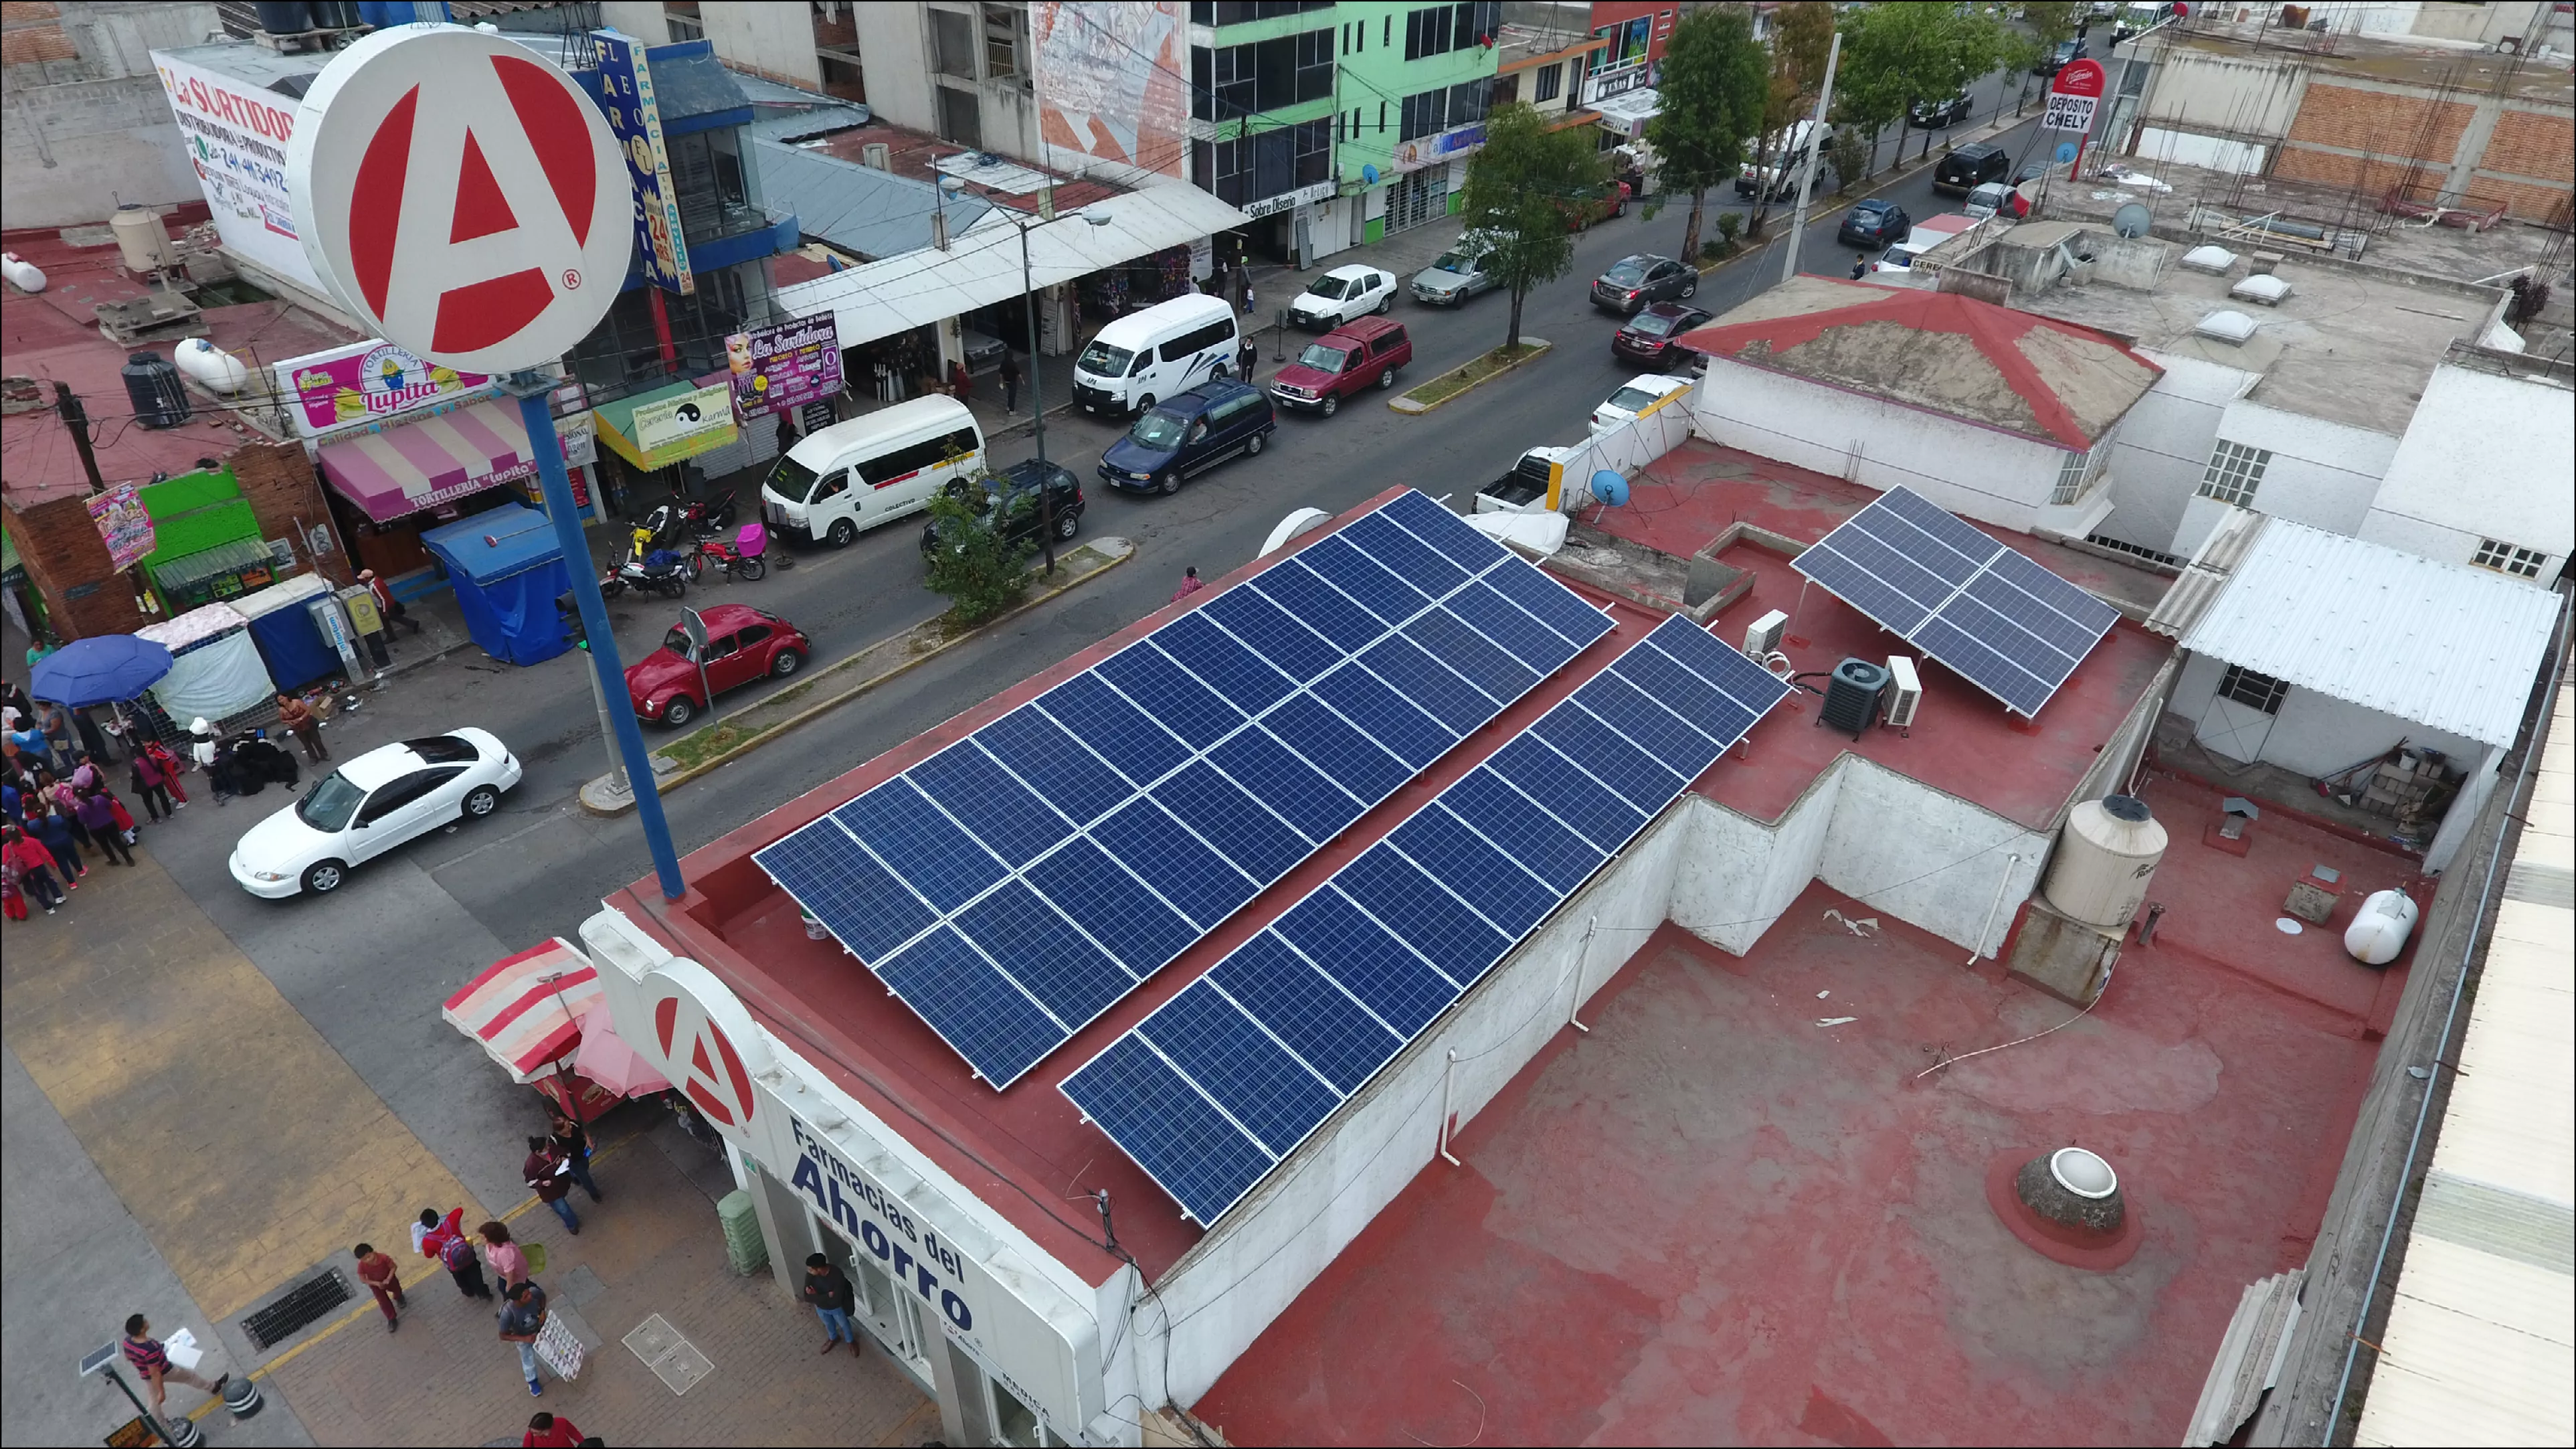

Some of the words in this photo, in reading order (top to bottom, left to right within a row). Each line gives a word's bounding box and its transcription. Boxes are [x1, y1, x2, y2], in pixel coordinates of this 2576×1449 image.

[169, 68, 193, 107] La
[634, 45, 668, 171] FARMACIA
[2046, 112, 2089, 129] CHELY
[2049, 96, 2094, 114] DEPOSITO
[1250, 202, 1271, 218] Sobre
[1272, 194, 1296, 213] Diseño
[650, 214, 668, 244] 24
[668, 207, 686, 268] SERVICIO
[680, 271, 692, 283] 24
[753, 339, 773, 360] La
[774, 325, 834, 353] Surtidora
[360, 380, 440, 414] Lupita
[410, 479, 482, 508] TORTILLERIA
[884, 498, 915, 512] COLECTIVO
[789, 1114, 919, 1244] Farmacias
[923, 1230, 965, 1285] del
[791, 1151, 973, 1332] Ahorro
